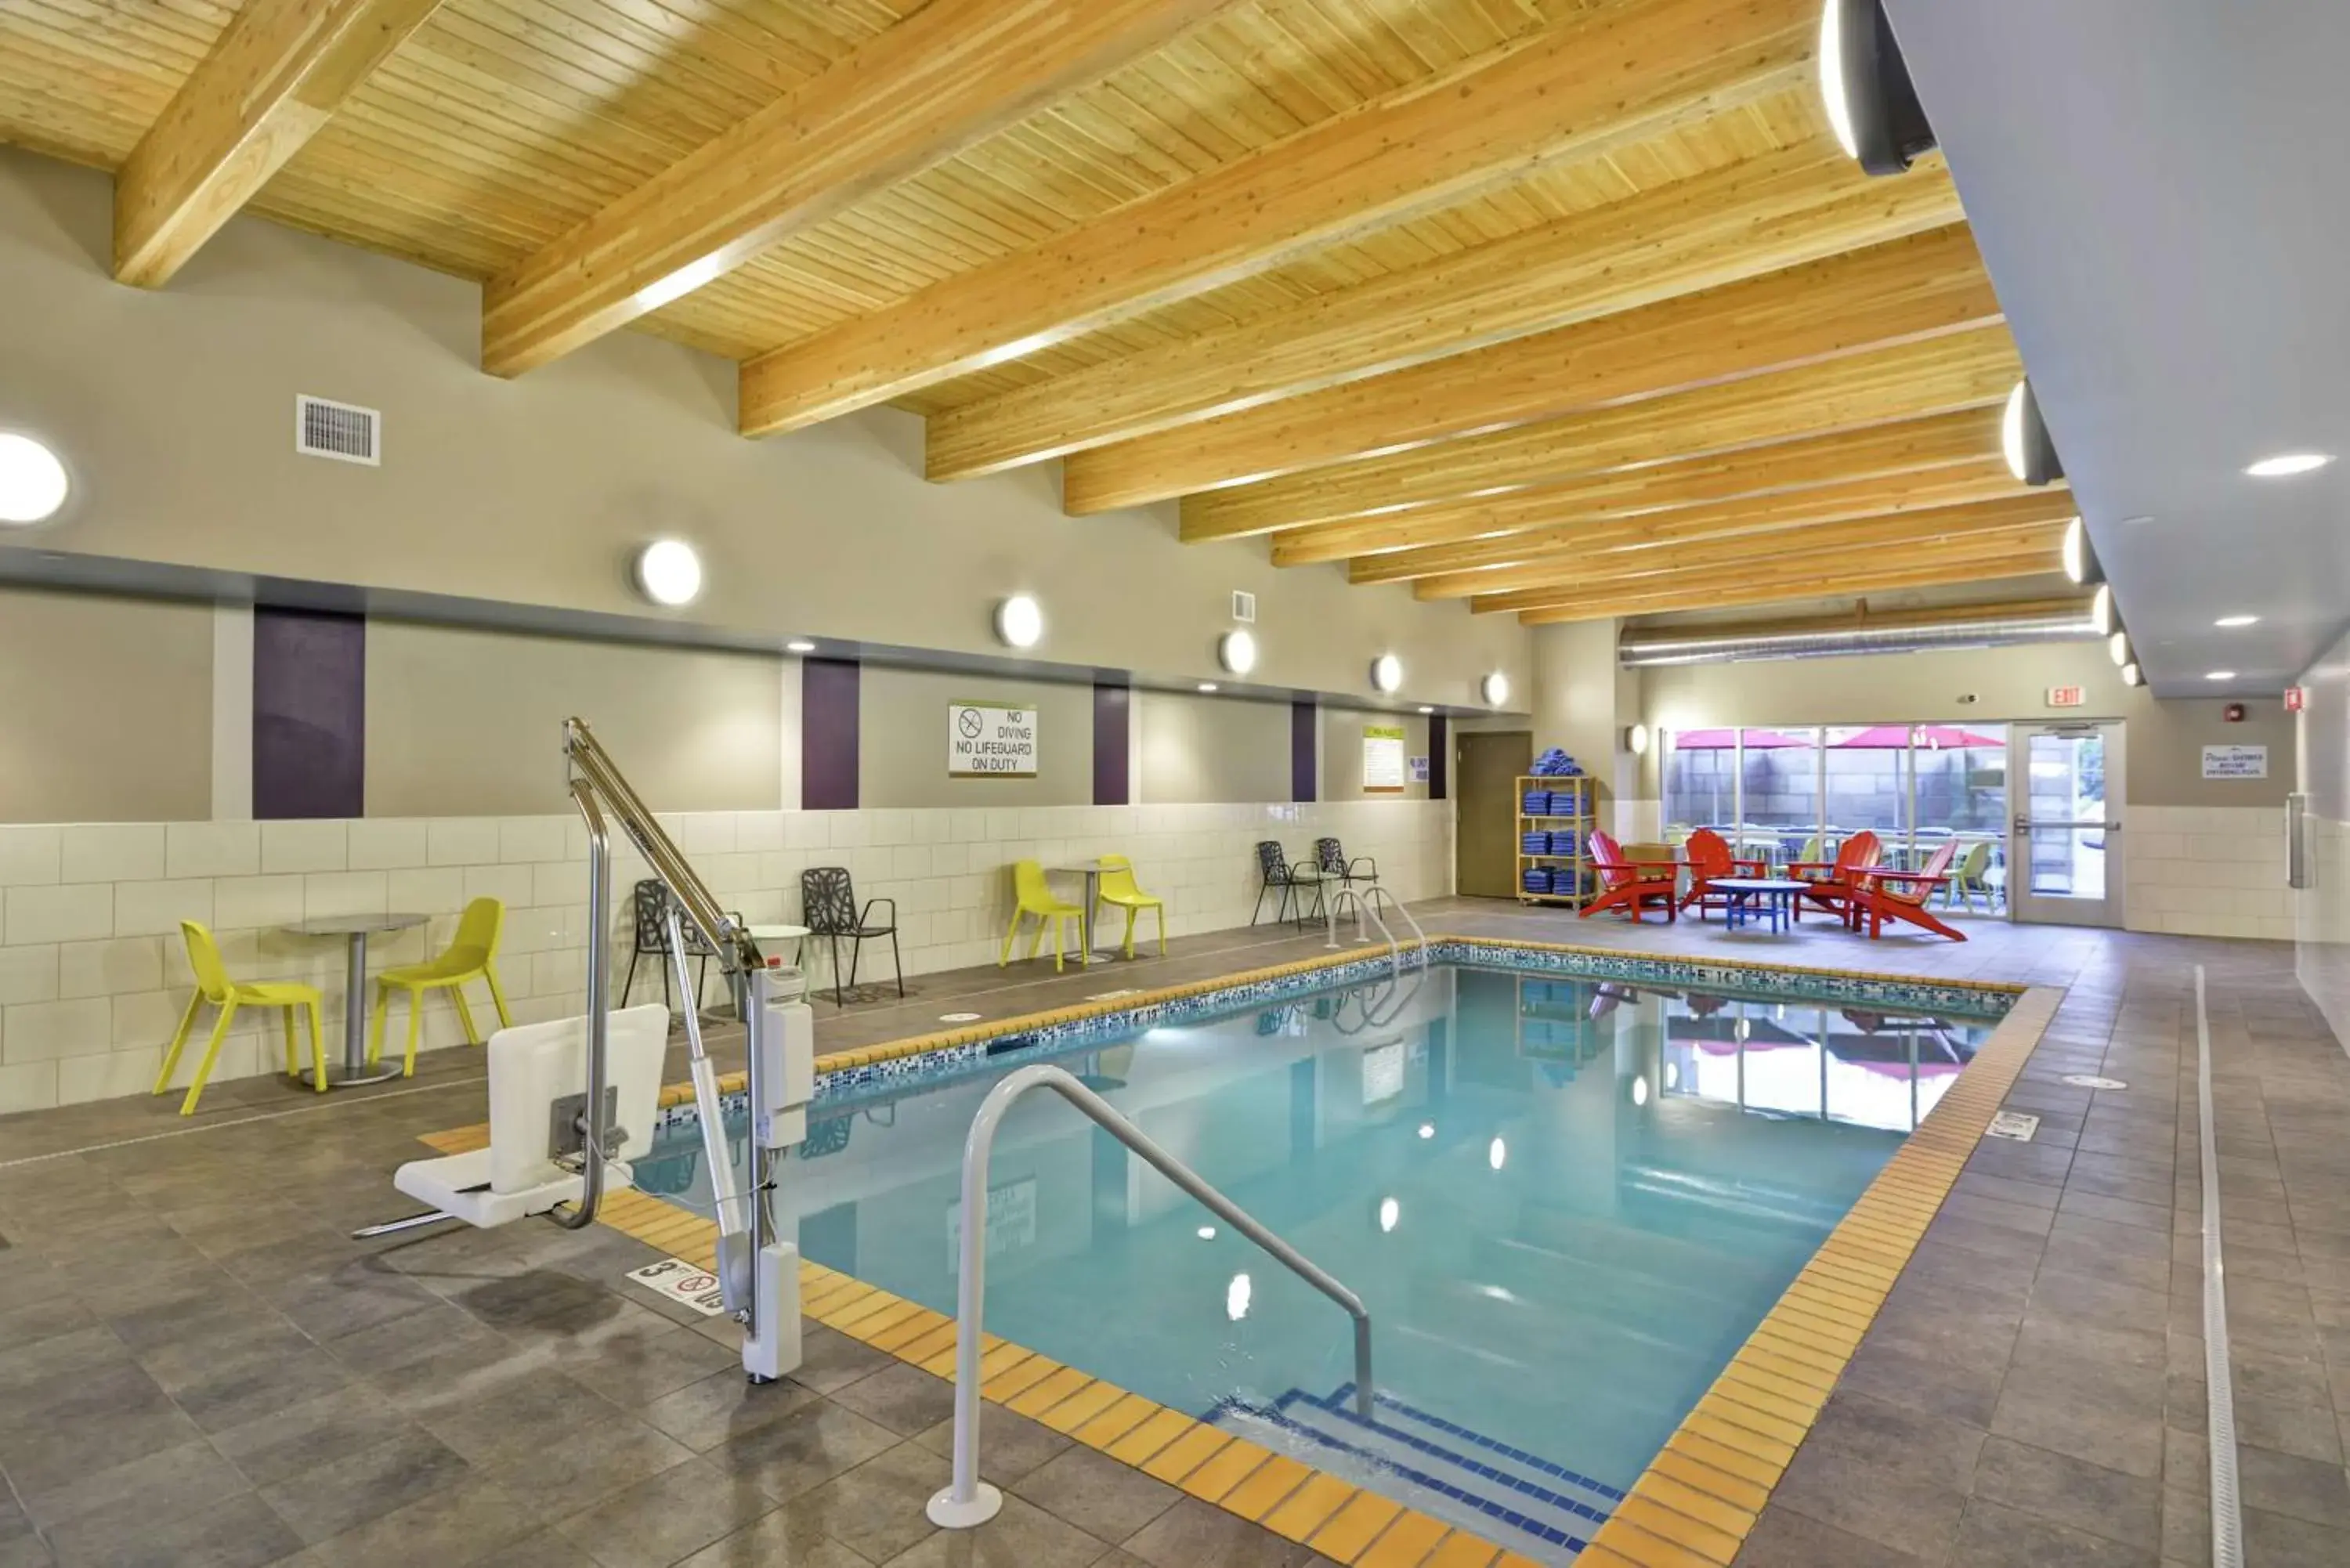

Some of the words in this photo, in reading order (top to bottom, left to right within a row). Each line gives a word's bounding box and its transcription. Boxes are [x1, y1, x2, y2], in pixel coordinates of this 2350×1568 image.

[2055, 688, 2079, 704] EXIT
[1007, 711, 1022, 723] NO
[997, 726, 1032, 739] DIVING
[956, 740, 972, 754] NO
[975, 742, 1032, 756] LIFEGUARD
[972, 757, 988, 770] ON
[990, 757, 1018, 771] DUTY
